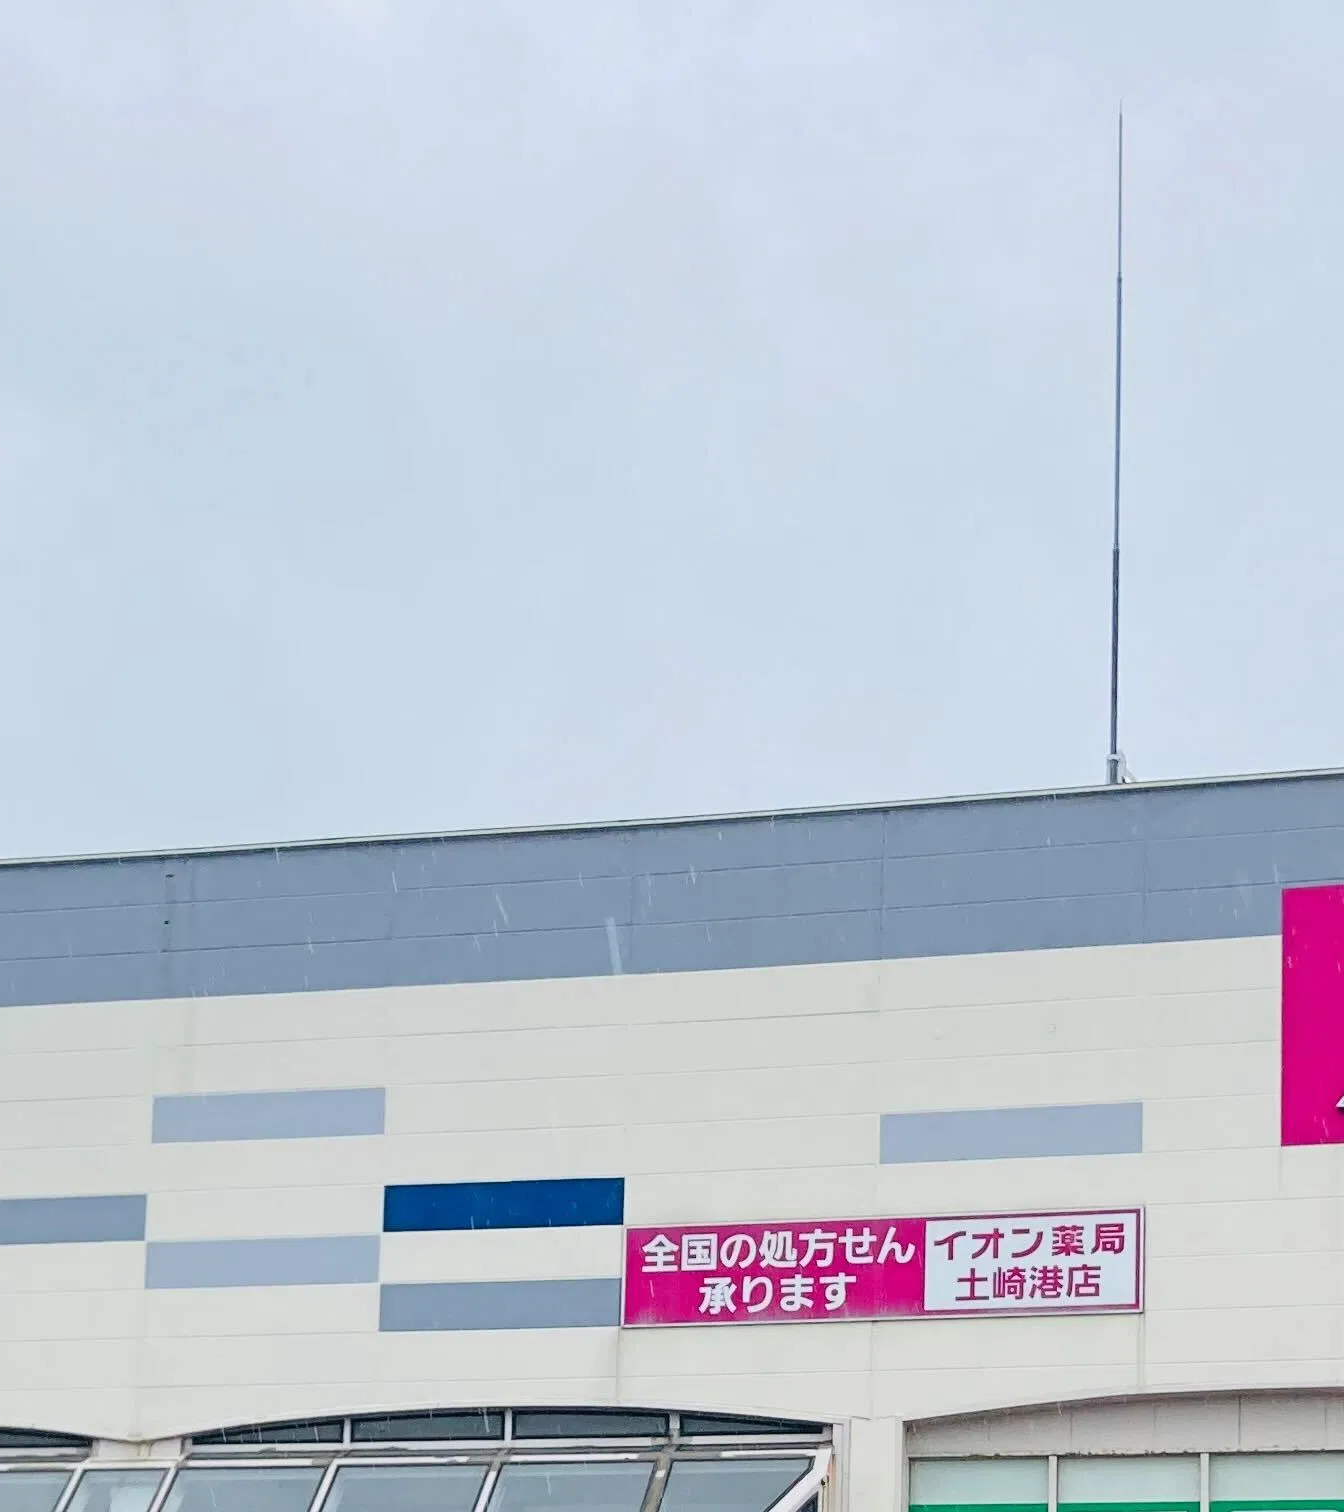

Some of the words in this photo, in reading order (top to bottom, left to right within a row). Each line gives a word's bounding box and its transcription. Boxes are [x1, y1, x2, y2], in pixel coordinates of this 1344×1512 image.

[640, 1226, 916, 1273] 全国の処方せん
[933, 1224, 1127, 1261] イオン薬局
[697, 1273, 858, 1316] 承ります
[956, 1264, 1101, 1301] 土崎港店
